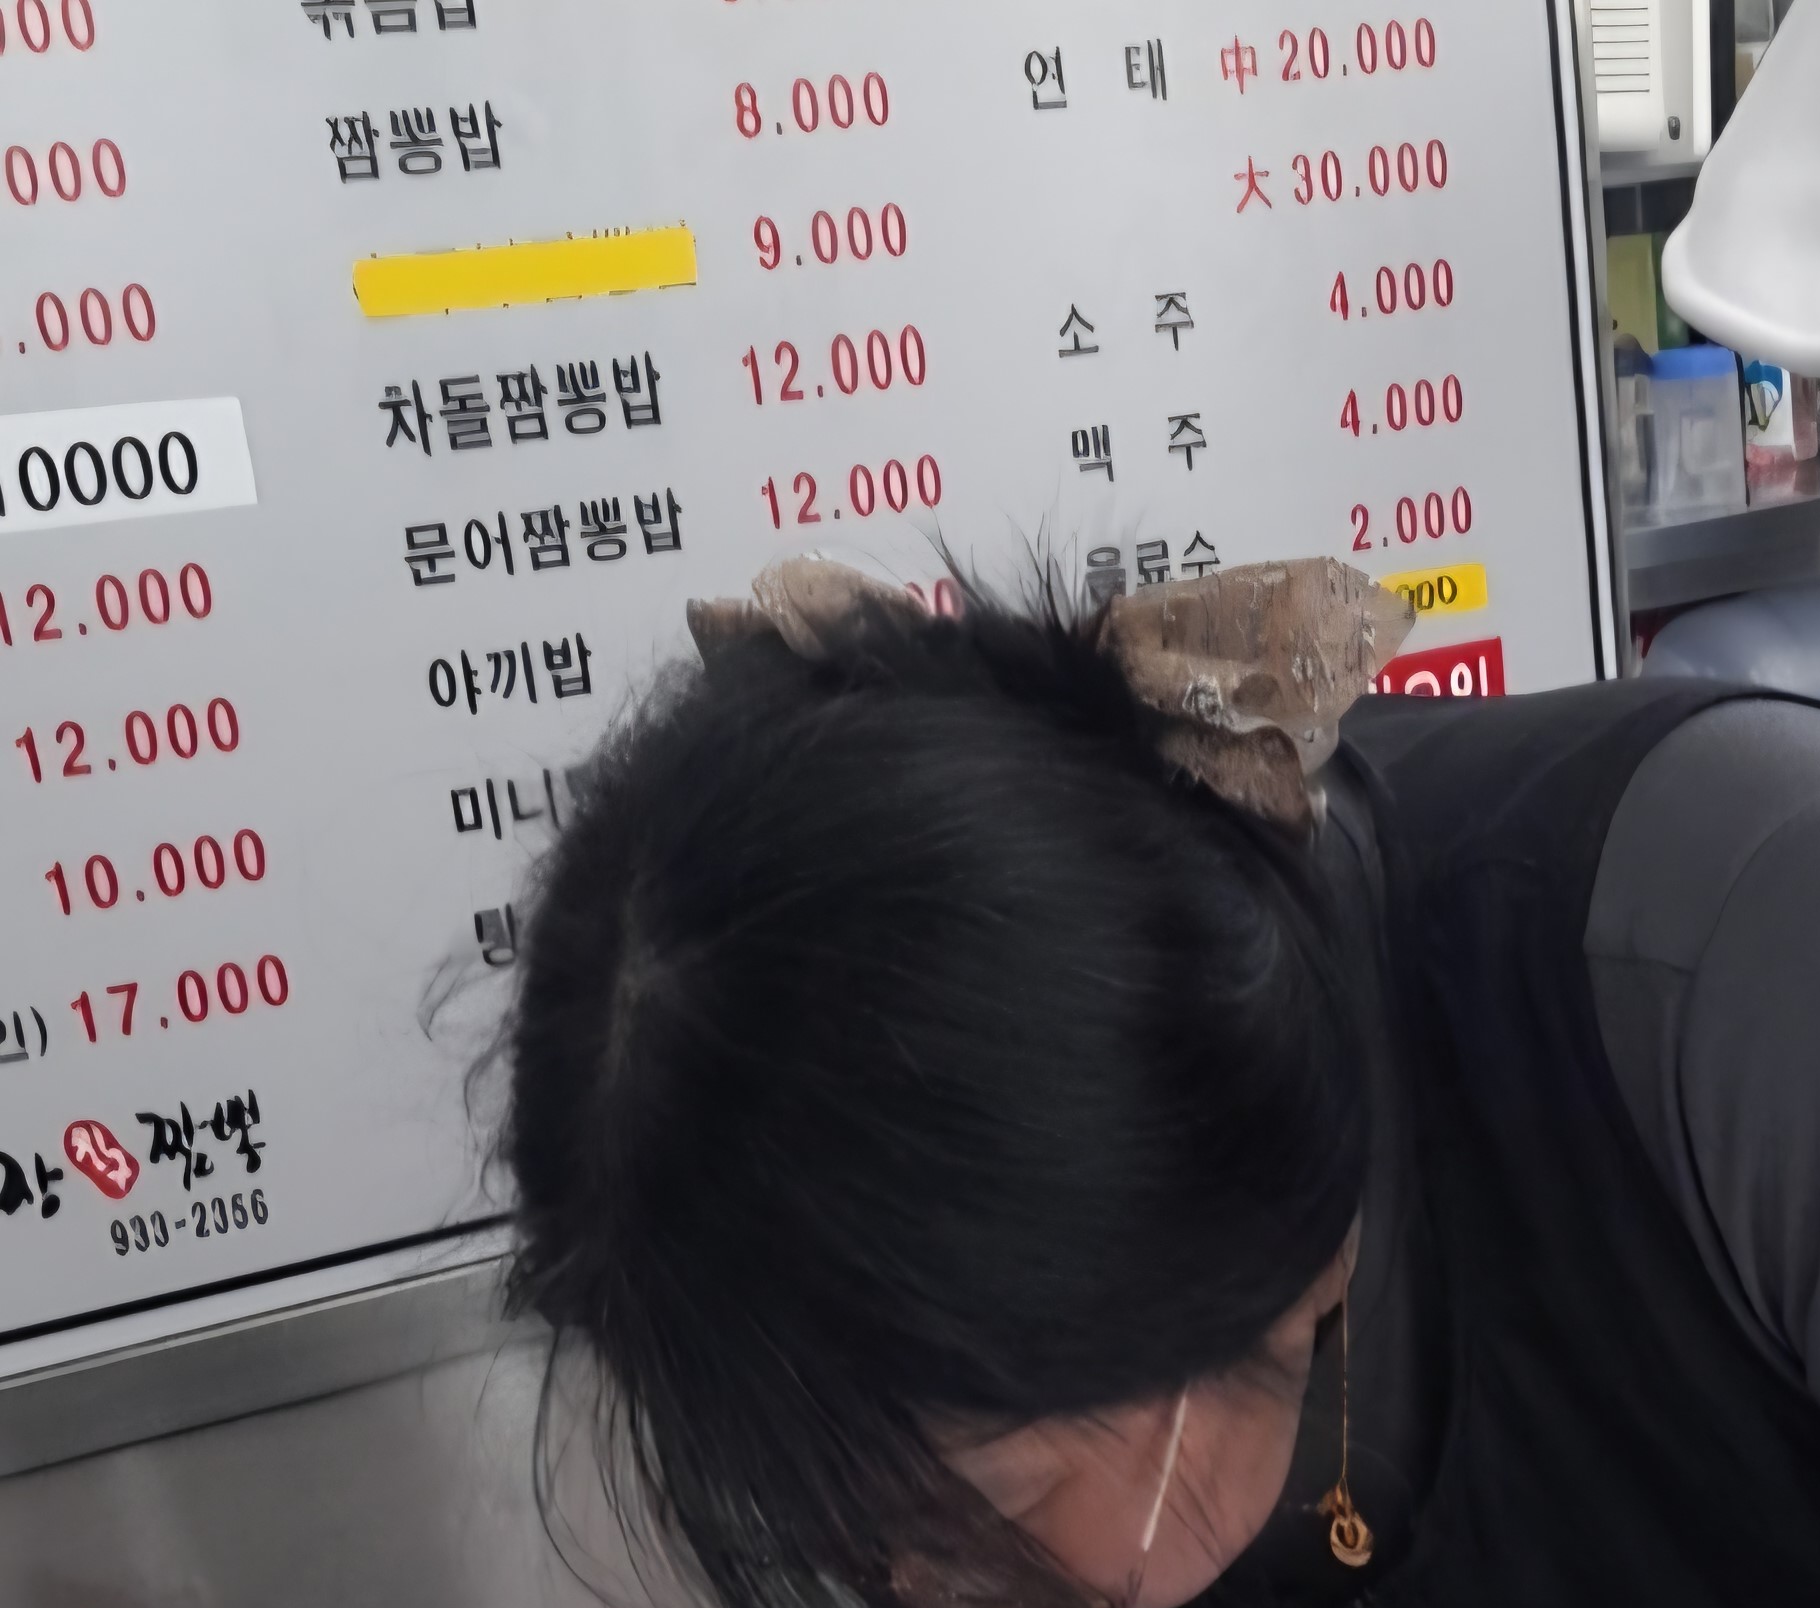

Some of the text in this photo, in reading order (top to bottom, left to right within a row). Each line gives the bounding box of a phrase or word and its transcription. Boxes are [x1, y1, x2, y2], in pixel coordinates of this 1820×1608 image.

[0, 0, 95, 56] 00
[1278, 17, 1437, 83] 20.000
[325, 71, 890, 185] 짬뽕밥 8.000
[1291, 138, 1449, 207] 30.000
[752, 202, 908, 272] 9.000
[377, 323, 927, 458] 차돌짬뽕밥 12.000
[1340, 373, 1464, 438] 4.000
[0, 431, 199, 517] 0000
[403, 453, 943, 588] 문어짬뽕밥 12.000
[1350, 485, 1473, 553] 2.000
[428, 632, 593, 716] 야끼밥
[14, 696, 241, 784] 12.000
[44, 828, 267, 917] 10.000
[70, 954, 290, 1044] 17.000
